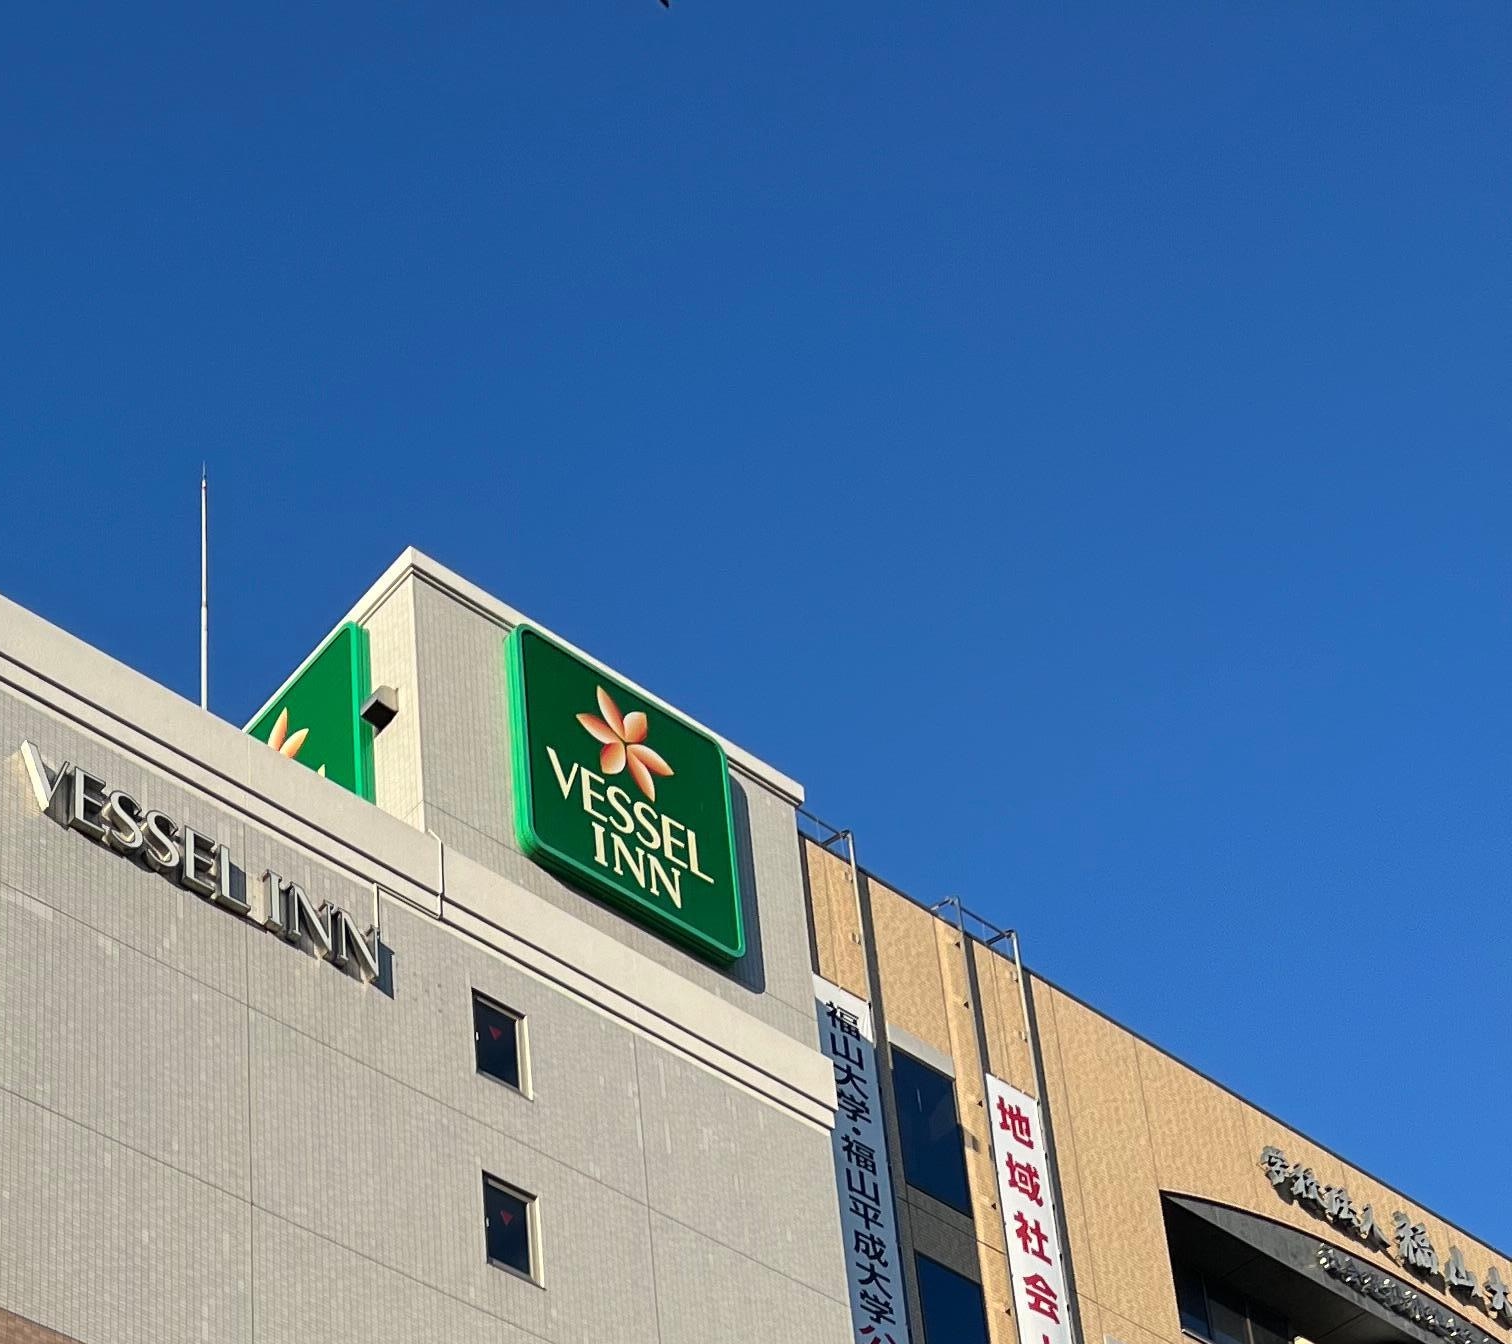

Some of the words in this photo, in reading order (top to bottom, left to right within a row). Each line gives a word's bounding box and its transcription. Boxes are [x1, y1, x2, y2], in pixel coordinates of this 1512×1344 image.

[20, 739, 251, 915] VESSEL
[262, 869, 380, 981] INN
[546, 745, 715, 885] VESSEL
[591, 821, 682, 909] INN
[826, 1001, 896, 1326] 福山大学・福山平成大学
